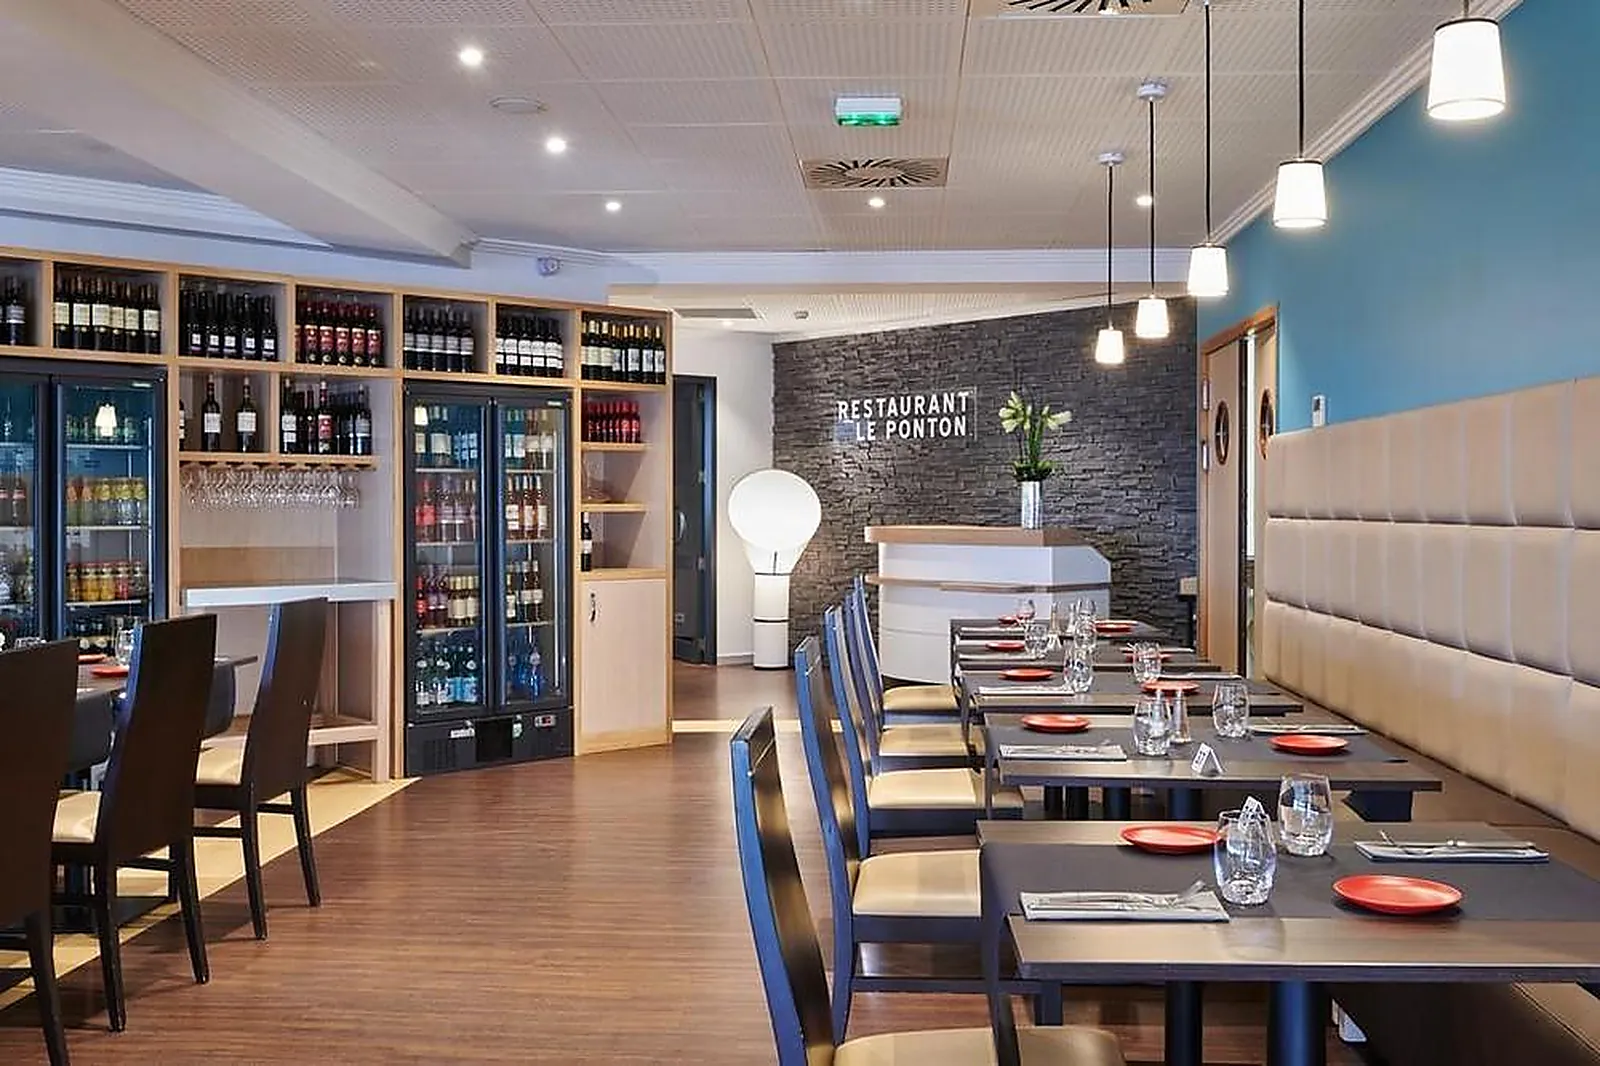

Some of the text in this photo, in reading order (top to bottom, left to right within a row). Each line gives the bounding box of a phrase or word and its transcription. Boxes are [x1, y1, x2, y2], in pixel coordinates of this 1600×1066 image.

[837, 391, 969, 420] RESTAURANT
[856, 415, 966, 441] LE PONTON
